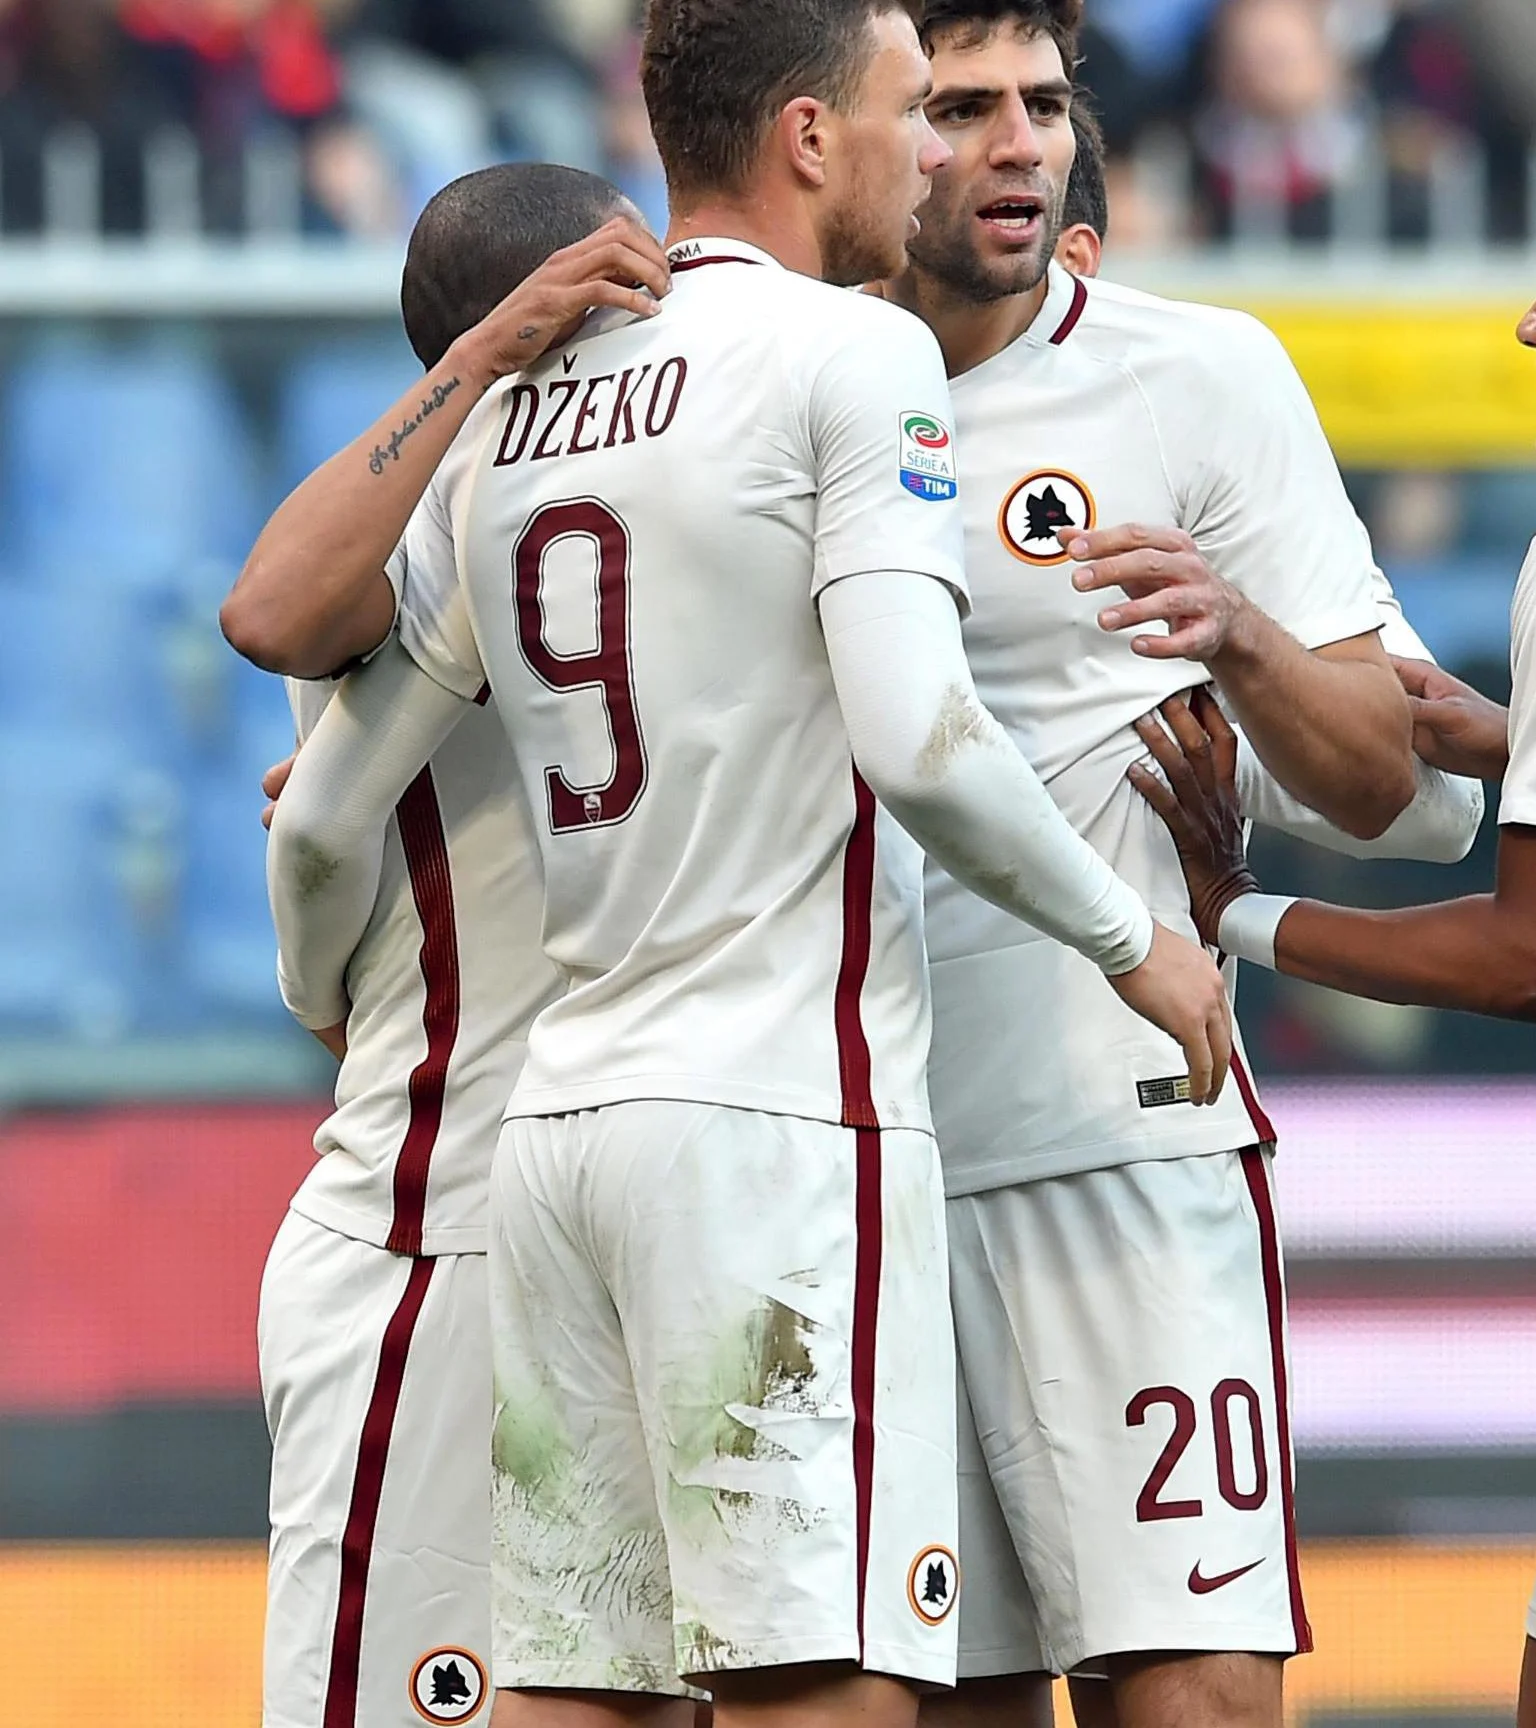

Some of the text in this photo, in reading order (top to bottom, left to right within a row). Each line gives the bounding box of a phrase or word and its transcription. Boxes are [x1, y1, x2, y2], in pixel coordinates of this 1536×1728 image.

[493, 353, 688, 467] DŽEKO
[906, 451, 938, 472] SERIE
[940, 461, 950, 474] A
[923, 480, 951, 497] TIM
[511, 494, 649, 835] 9
[1125, 1378, 1269, 1522] 20
